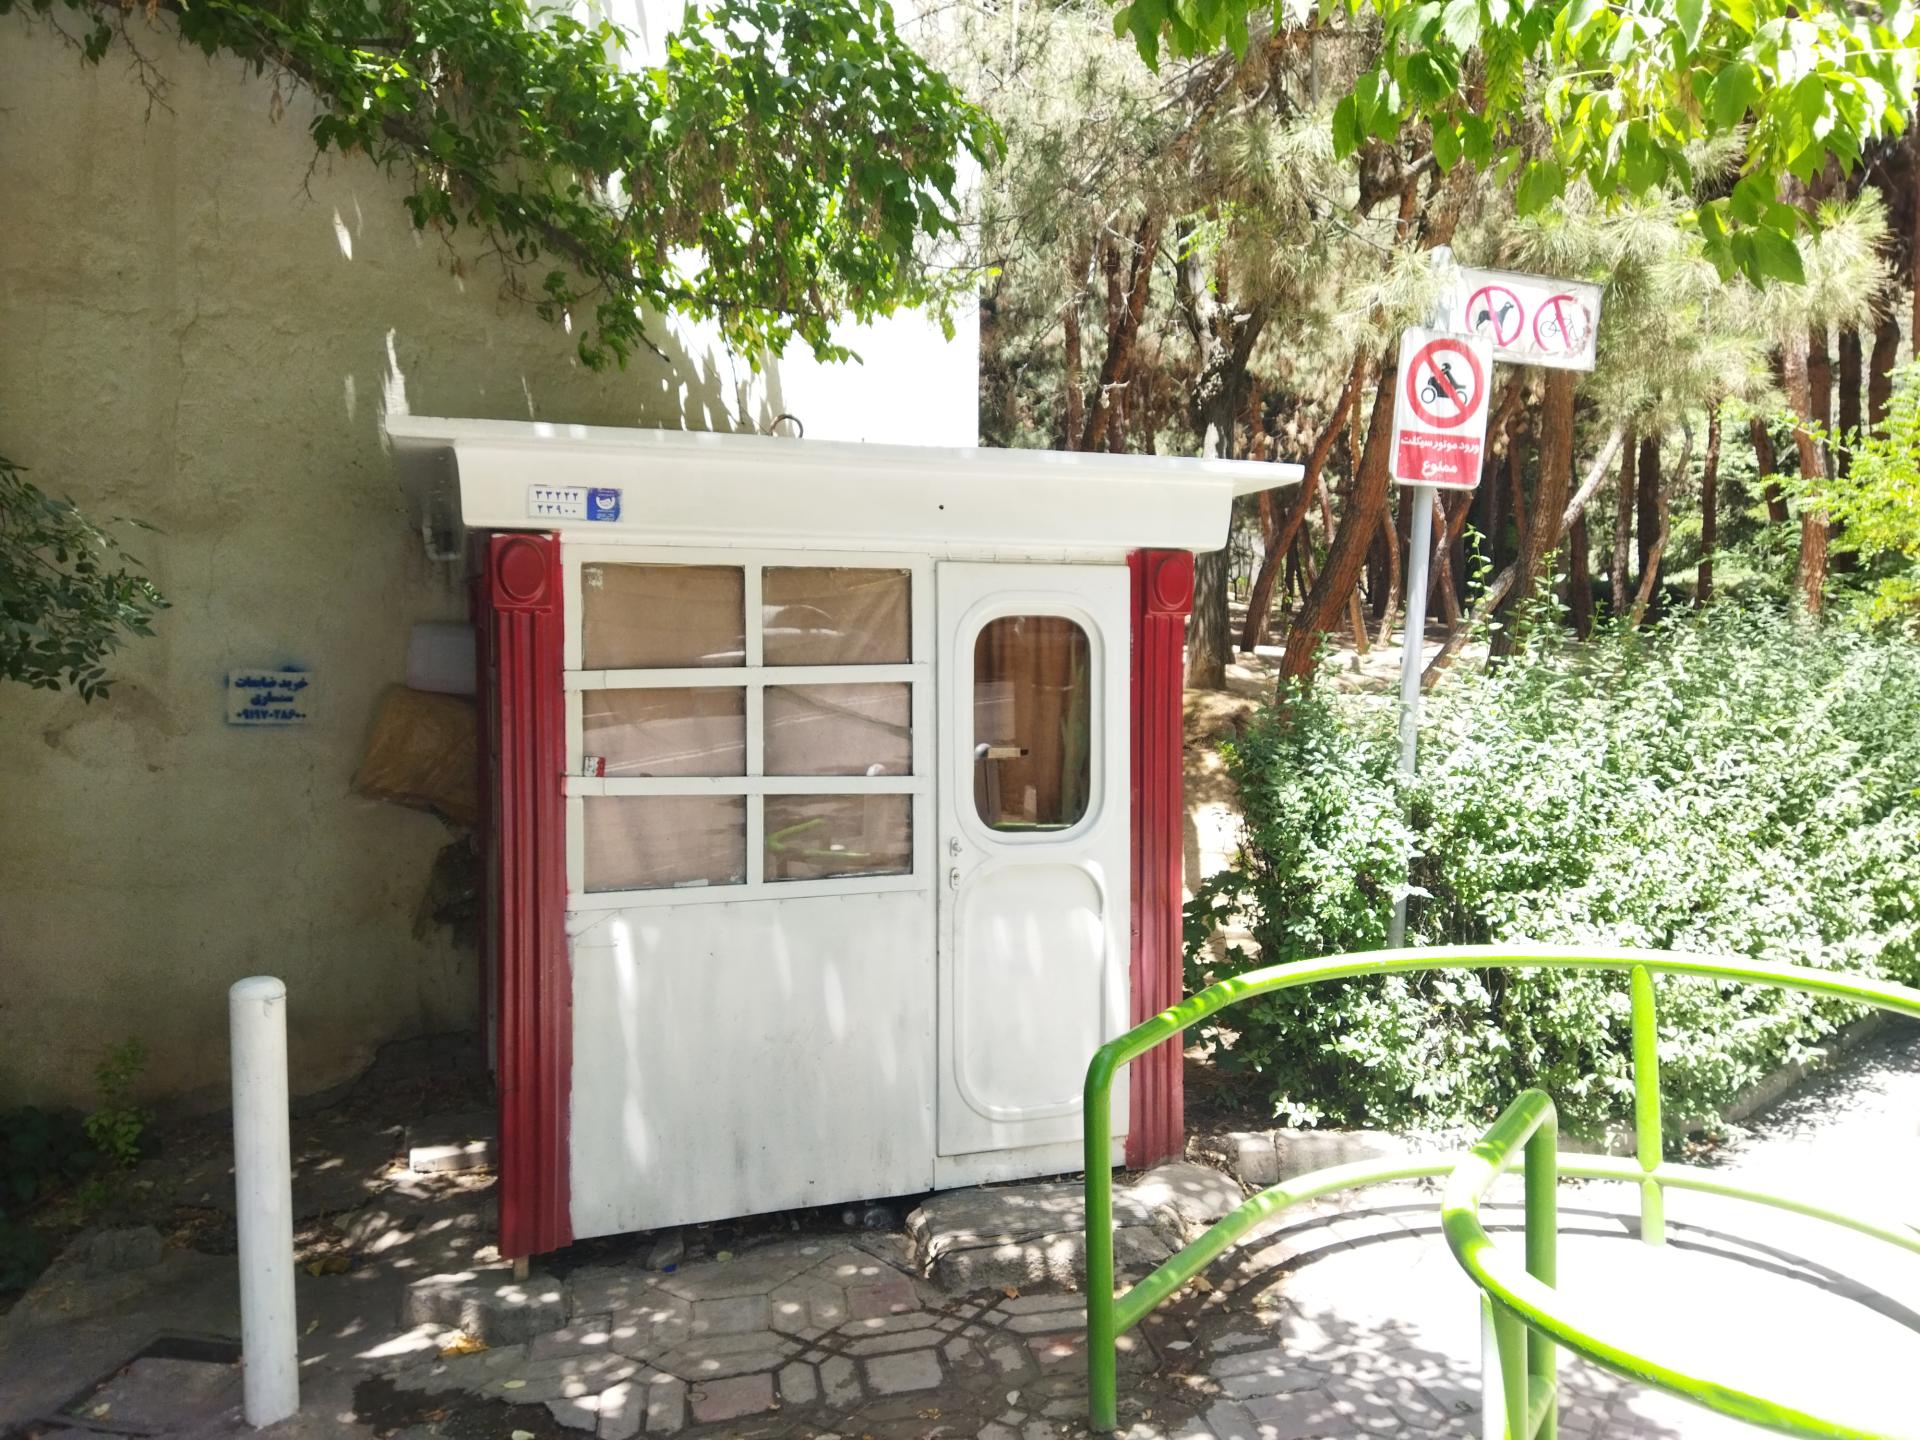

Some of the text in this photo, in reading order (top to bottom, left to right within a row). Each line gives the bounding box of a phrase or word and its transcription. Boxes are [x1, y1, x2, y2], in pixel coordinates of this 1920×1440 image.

[1458, 441, 1480, 455] ورود
[1421, 460, 1458, 478] ممنوع
[278, 677, 308, 692] خرید
